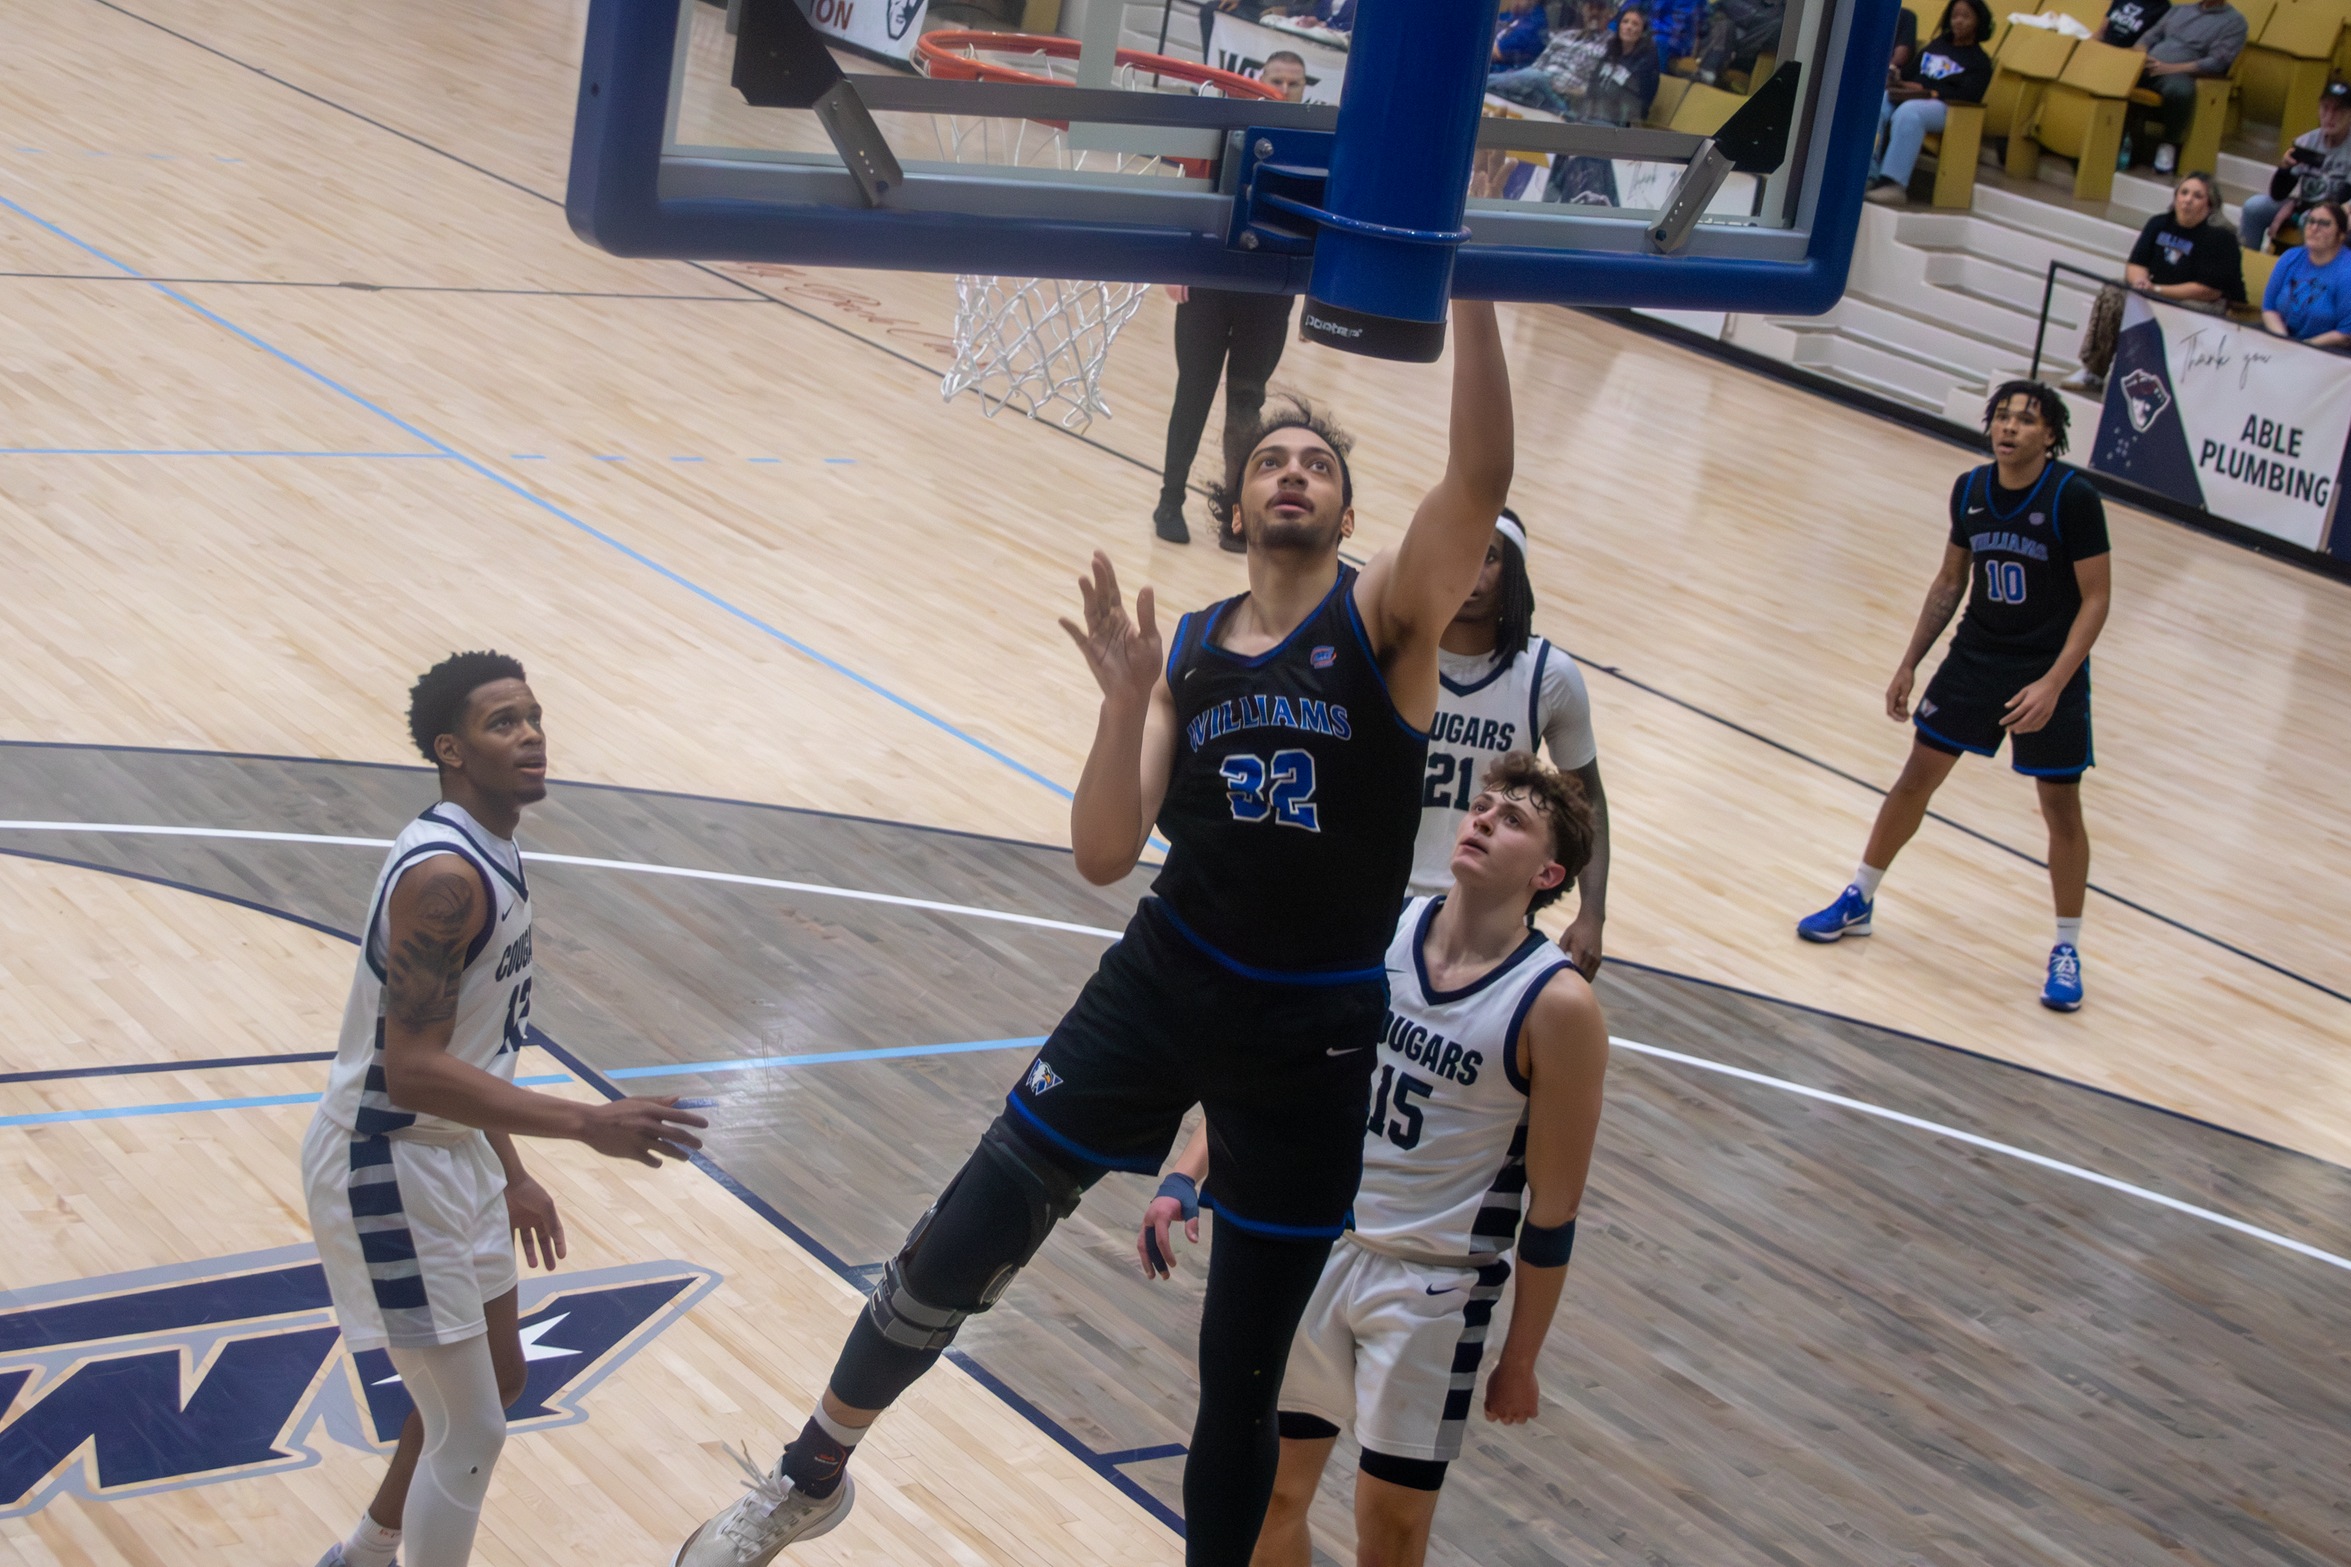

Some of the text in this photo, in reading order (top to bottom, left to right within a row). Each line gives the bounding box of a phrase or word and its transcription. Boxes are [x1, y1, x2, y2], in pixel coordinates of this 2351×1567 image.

[2180, 328, 2271, 390] Thank you
[2241, 414, 2303, 458] ABLE
[2199, 438, 2330, 507] PLUMBING
[1969, 531, 2048, 561] WILLIAMS
[1985, 560, 2026, 604] 10
[1187, 694, 1352, 752] WILLIAMS
[1219, 748, 1321, 833] 32
[1422, 752, 1474, 811] 21
[1367, 1063, 1433, 1151] 15
